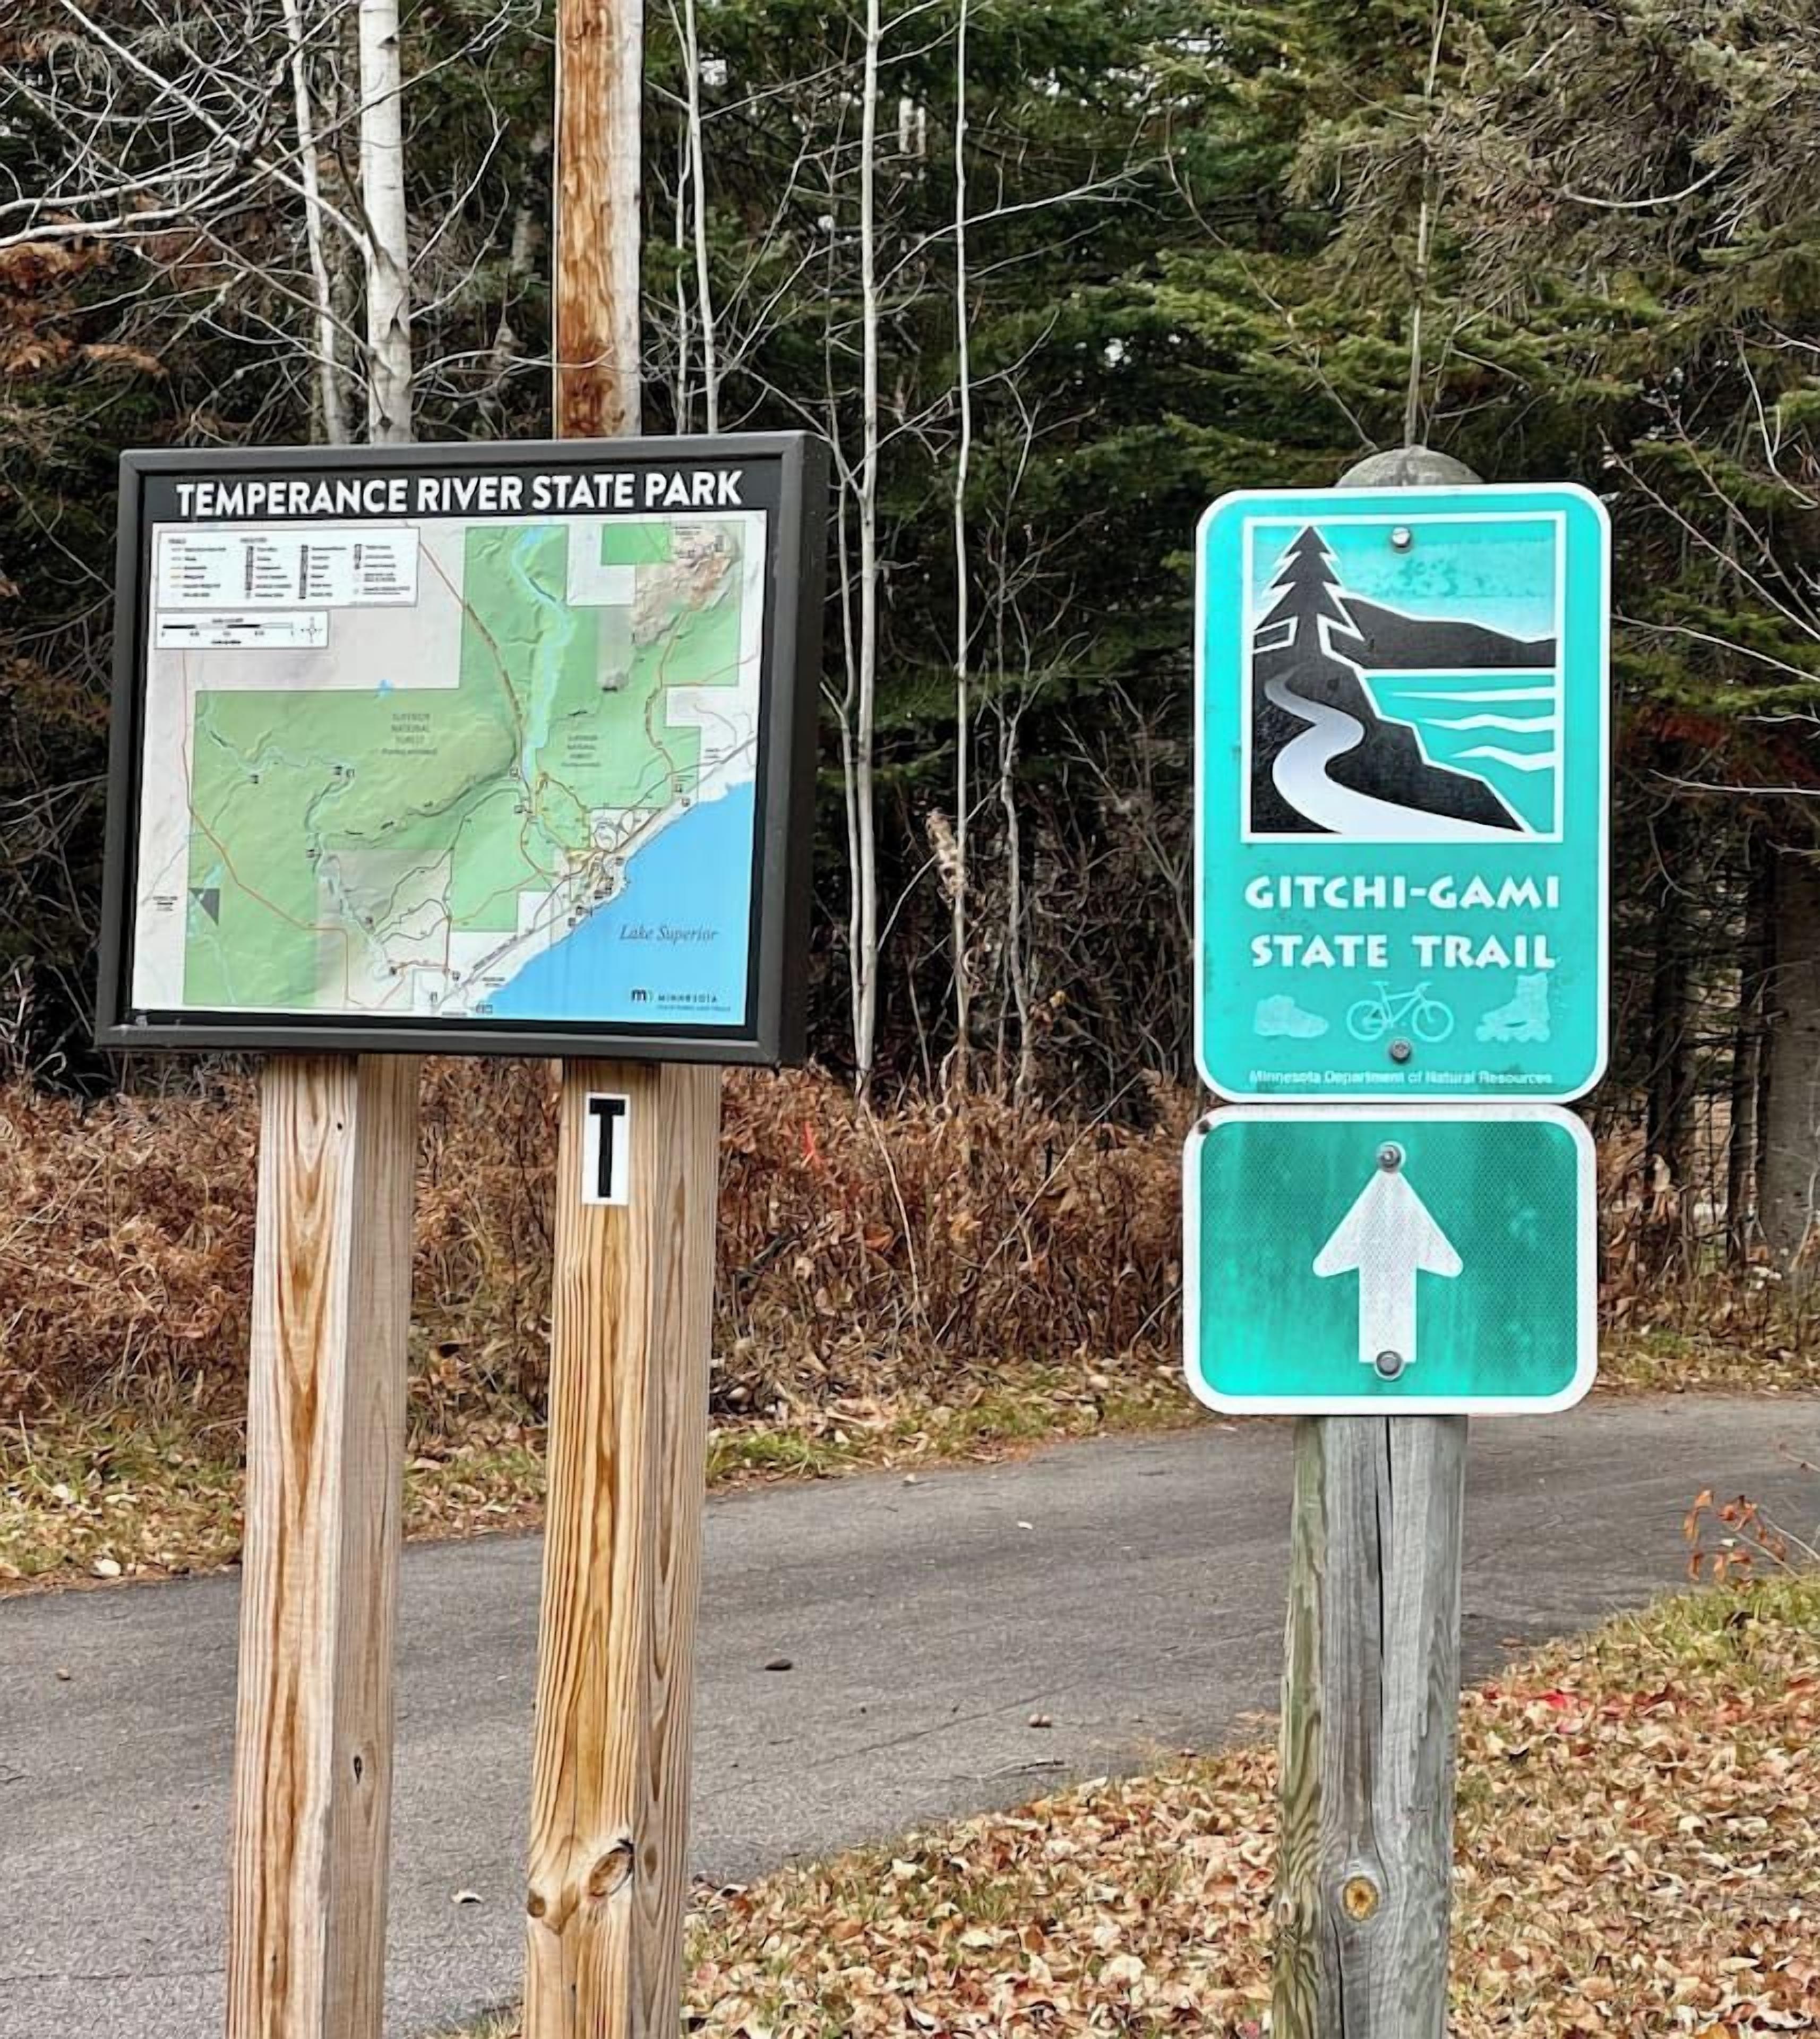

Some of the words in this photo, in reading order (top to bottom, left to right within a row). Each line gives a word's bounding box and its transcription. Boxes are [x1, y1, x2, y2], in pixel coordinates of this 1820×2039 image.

[176, 479, 408, 517] TEMPERANCE
[417, 476, 523, 512] RIVER
[531, 473, 635, 509] STATE
[645, 470, 743, 507] PARK
[1245, 875, 1558, 909] GITCHI-GAMI
[620, 924, 654, 939] Lake
[656, 924, 719, 945] Superior
[1251, 935, 1388, 969] STATE
[1412, 935, 1556, 969] TRAIL
[1249, 1070, 1321, 1084] Minnesota
[1325, 1070, 1404, 1085] Department
[1407, 1070, 1423, 1084] of
[1425, 1070, 1475, 1084] Natural
[1478, 1070, 1552, 1085] Resources
[589, 1098, 625, 1198] T
